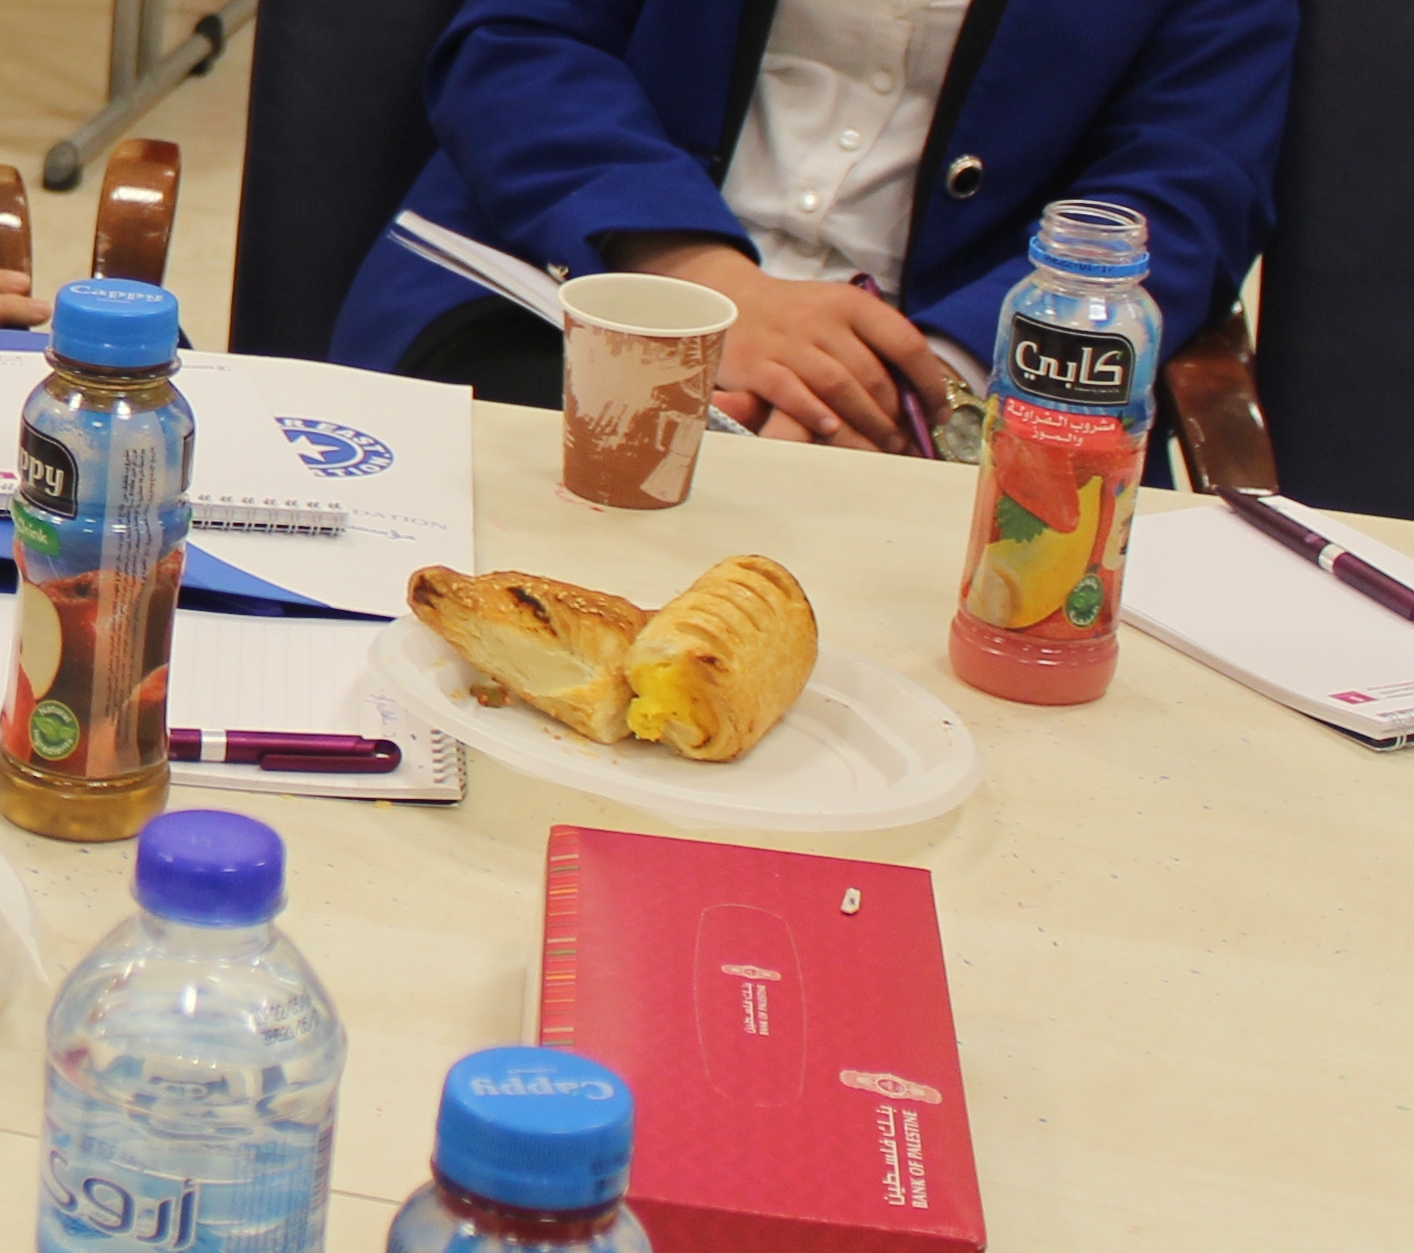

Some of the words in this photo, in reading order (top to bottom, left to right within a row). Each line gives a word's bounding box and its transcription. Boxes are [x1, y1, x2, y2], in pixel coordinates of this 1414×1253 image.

[1015, 340, 1124, 389] كابي
[1007, 400, 1068, 429] الفراولة
[1070, 417, 1116, 434] مشروب
[1032, 427, 1084, 447] والموز
[352, 508, 447, 530] DATION
[471, 1076, 614, 1100] Cappy
[902, 1109, 923, 1160] PALESTINE
[908, 1160, 925, 1177] OF
[910, 1177, 928, 1209] BANK
